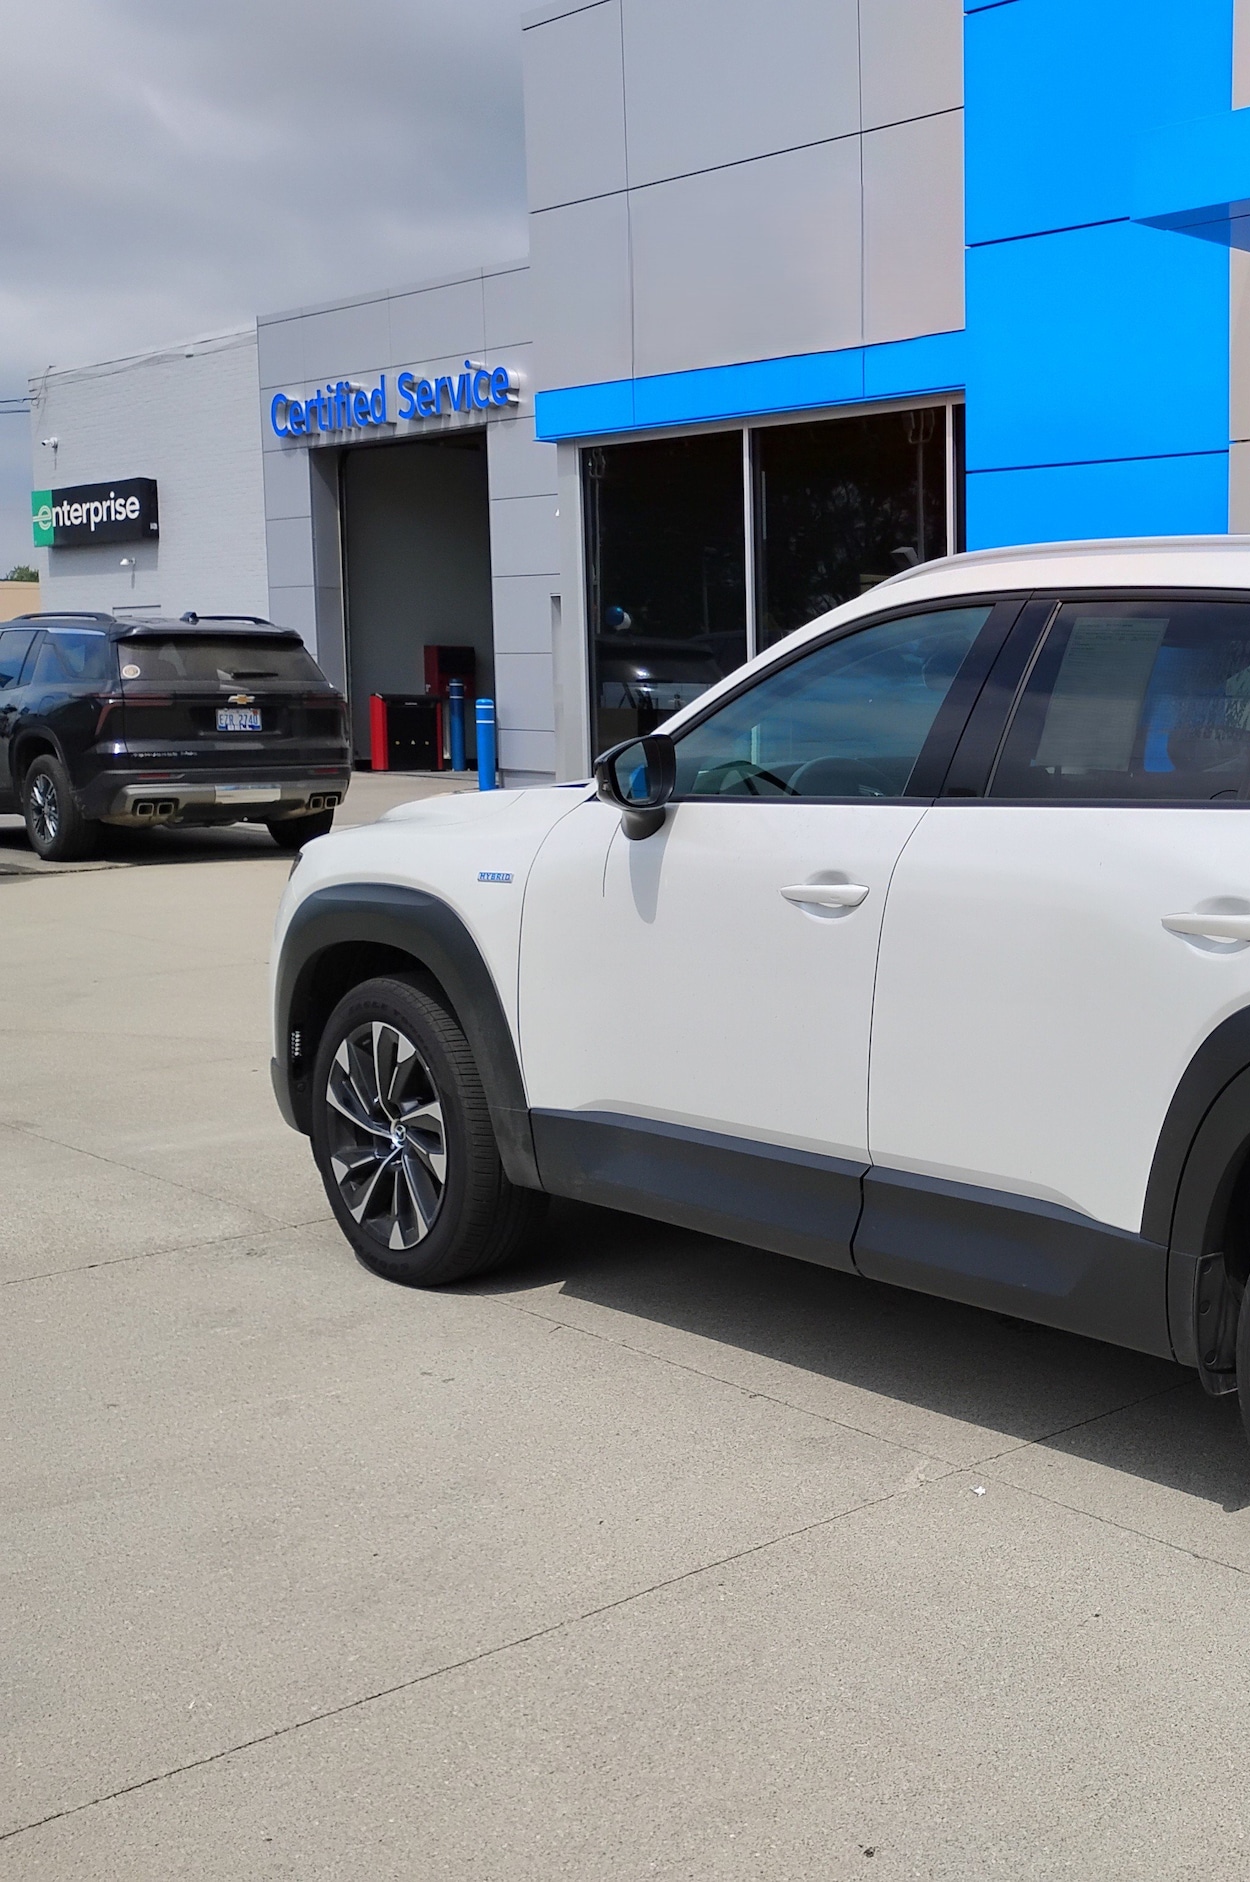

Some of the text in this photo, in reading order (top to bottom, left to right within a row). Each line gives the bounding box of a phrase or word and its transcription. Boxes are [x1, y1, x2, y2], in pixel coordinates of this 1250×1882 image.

[270, 359, 510, 438] Certified Service
[32, 490, 140, 532] enterprise
[479, 872, 511, 881] HYBRID
